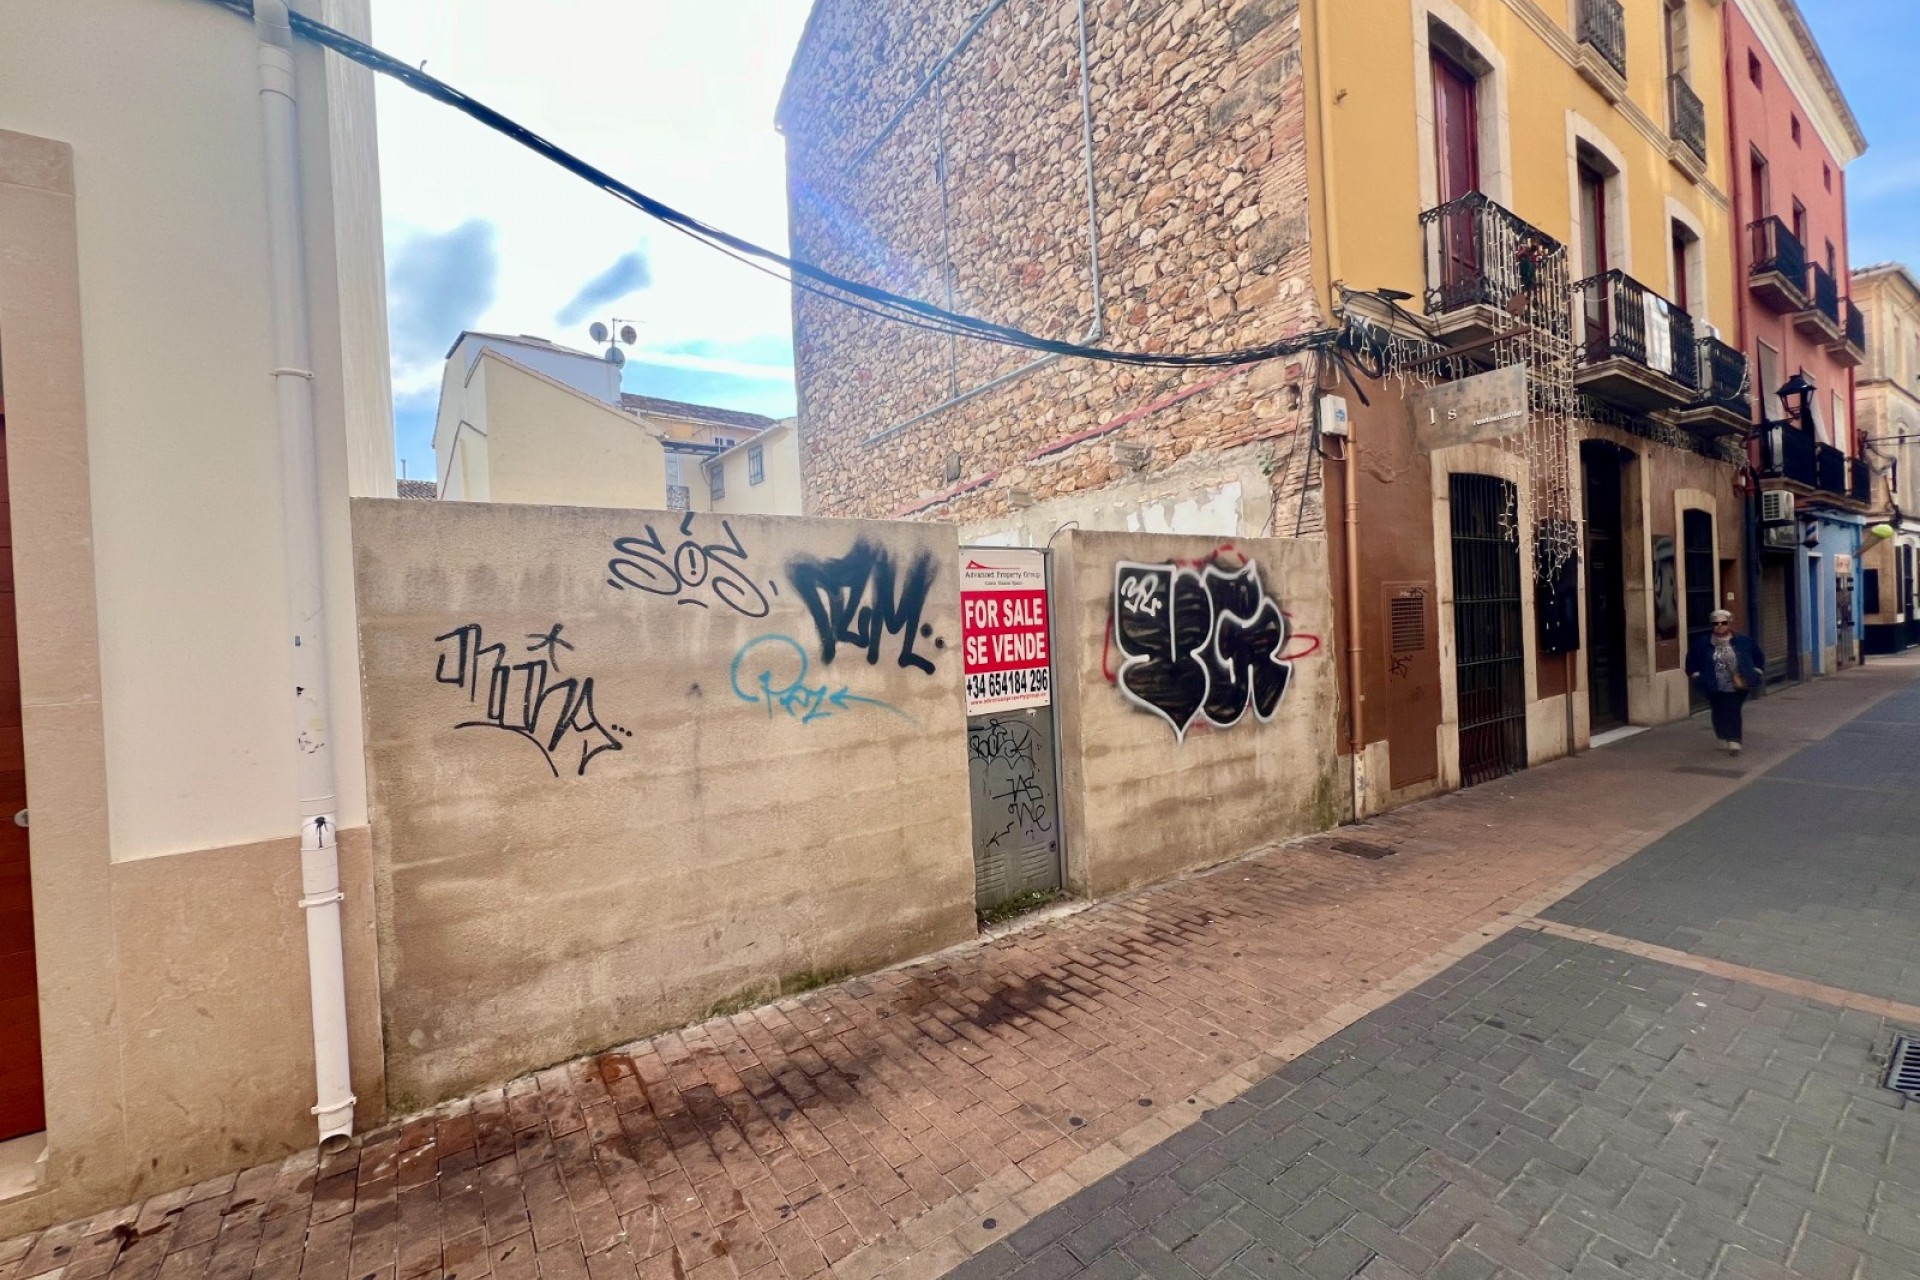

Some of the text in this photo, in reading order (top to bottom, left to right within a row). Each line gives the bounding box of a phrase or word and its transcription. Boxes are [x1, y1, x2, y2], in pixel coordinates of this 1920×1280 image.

[965, 570, 1041, 580] Advanced Property Group
[964, 598, 1043, 629] FOR SALE
[966, 632, 1046, 666] SE VENDE
[966, 674, 986, 699] +34
[1030, 668, 1049, 692] 296
